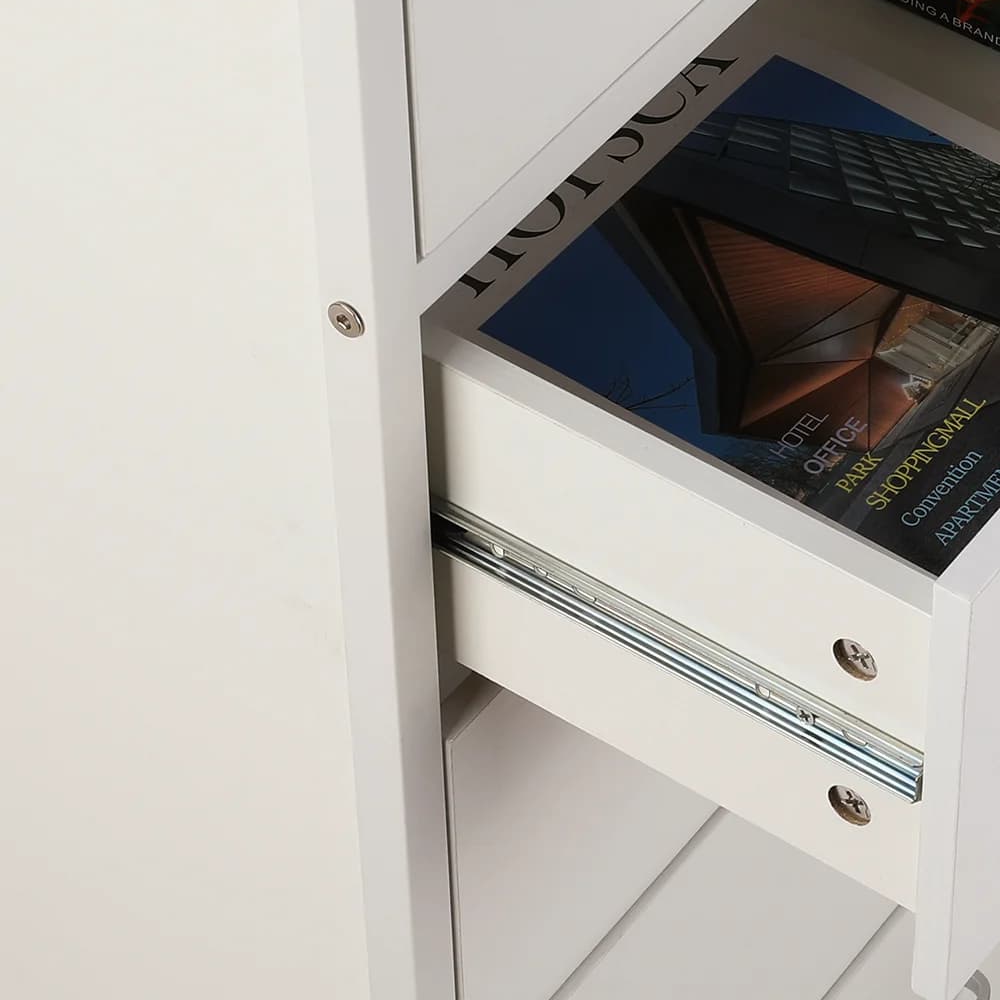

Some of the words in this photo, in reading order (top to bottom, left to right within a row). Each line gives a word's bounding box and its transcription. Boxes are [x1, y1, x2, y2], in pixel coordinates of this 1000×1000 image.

[940, 11, 950, 24] A
[769, 411, 830, 460] HOTEL
[803, 416, 868, 476] OFFICE
[865, 397, 987, 511] SHOPPINGMALL
[835, 451, 884, 494] PARK
[901, 450, 983, 527] Convention
